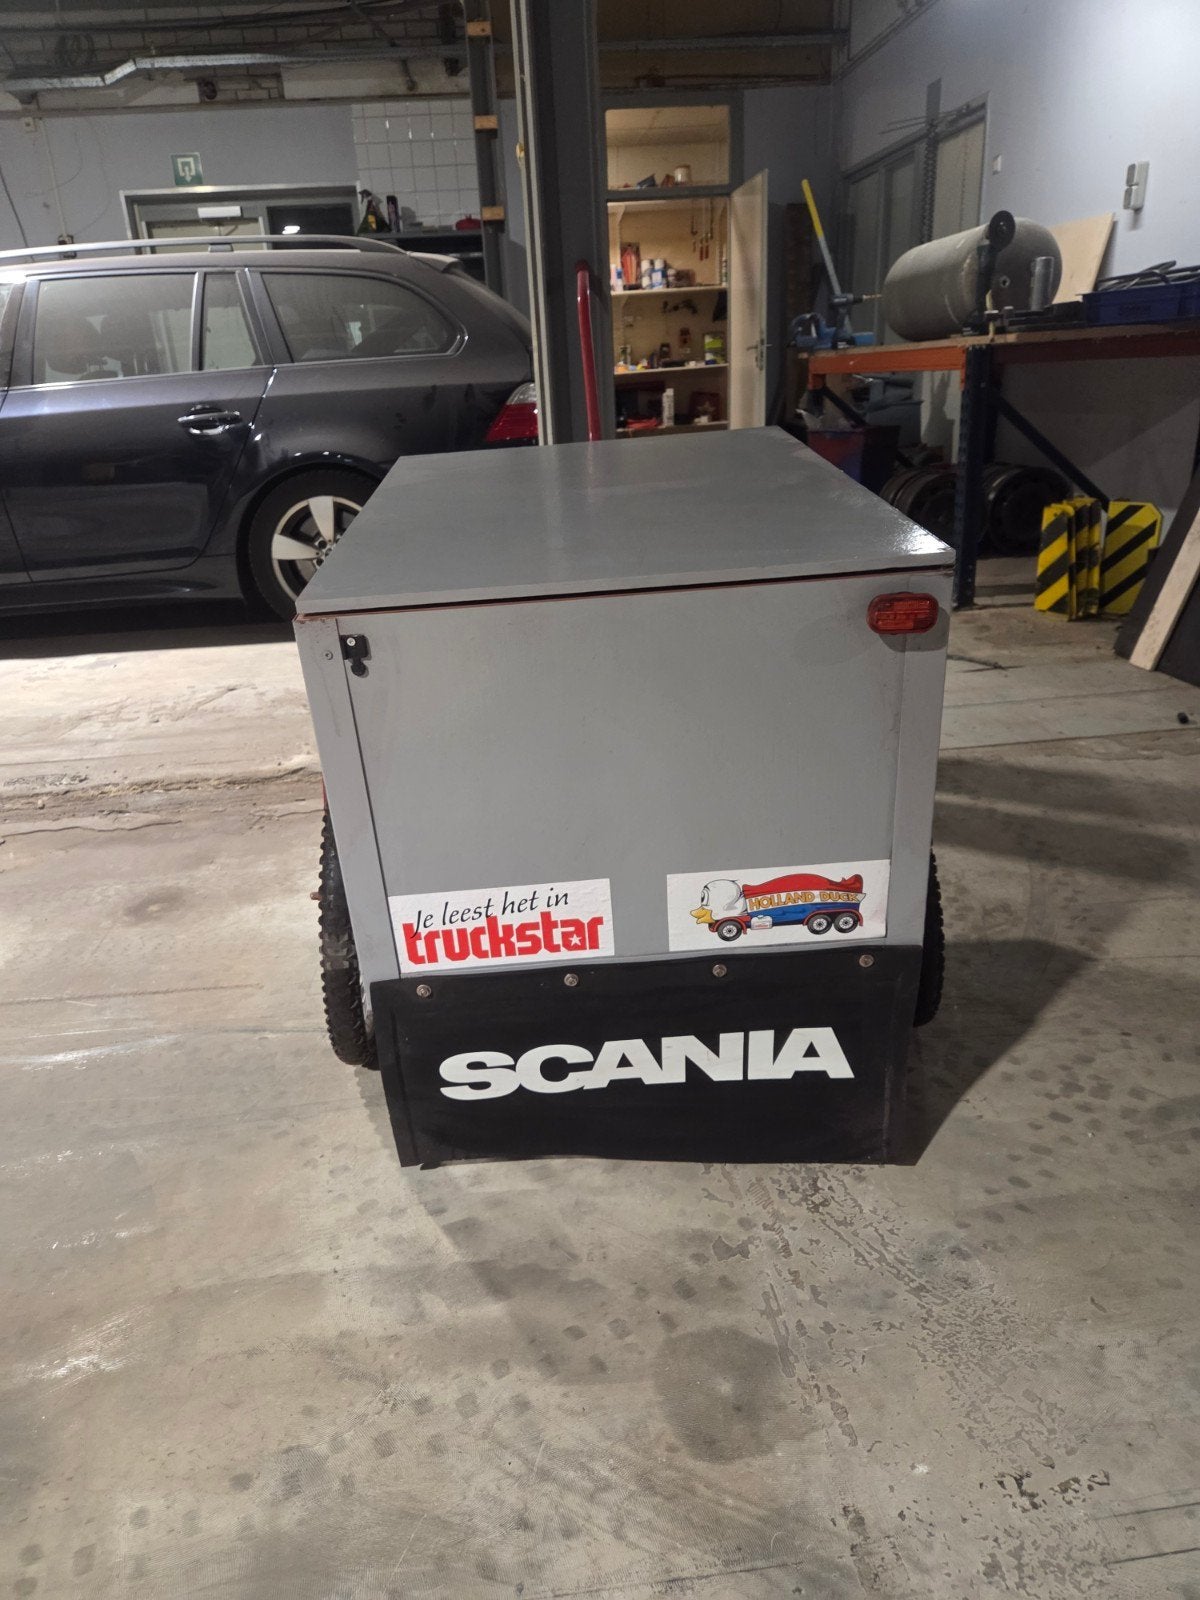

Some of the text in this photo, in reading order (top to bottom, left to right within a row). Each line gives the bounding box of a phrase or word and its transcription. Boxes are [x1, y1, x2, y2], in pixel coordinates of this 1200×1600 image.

[410, 887, 569, 938] Je leest het in
[749, 891, 859, 911] HOLLAND DUCK
[402, 911, 604, 965] truckstar
[439, 1026, 855, 1100] SCANIA
